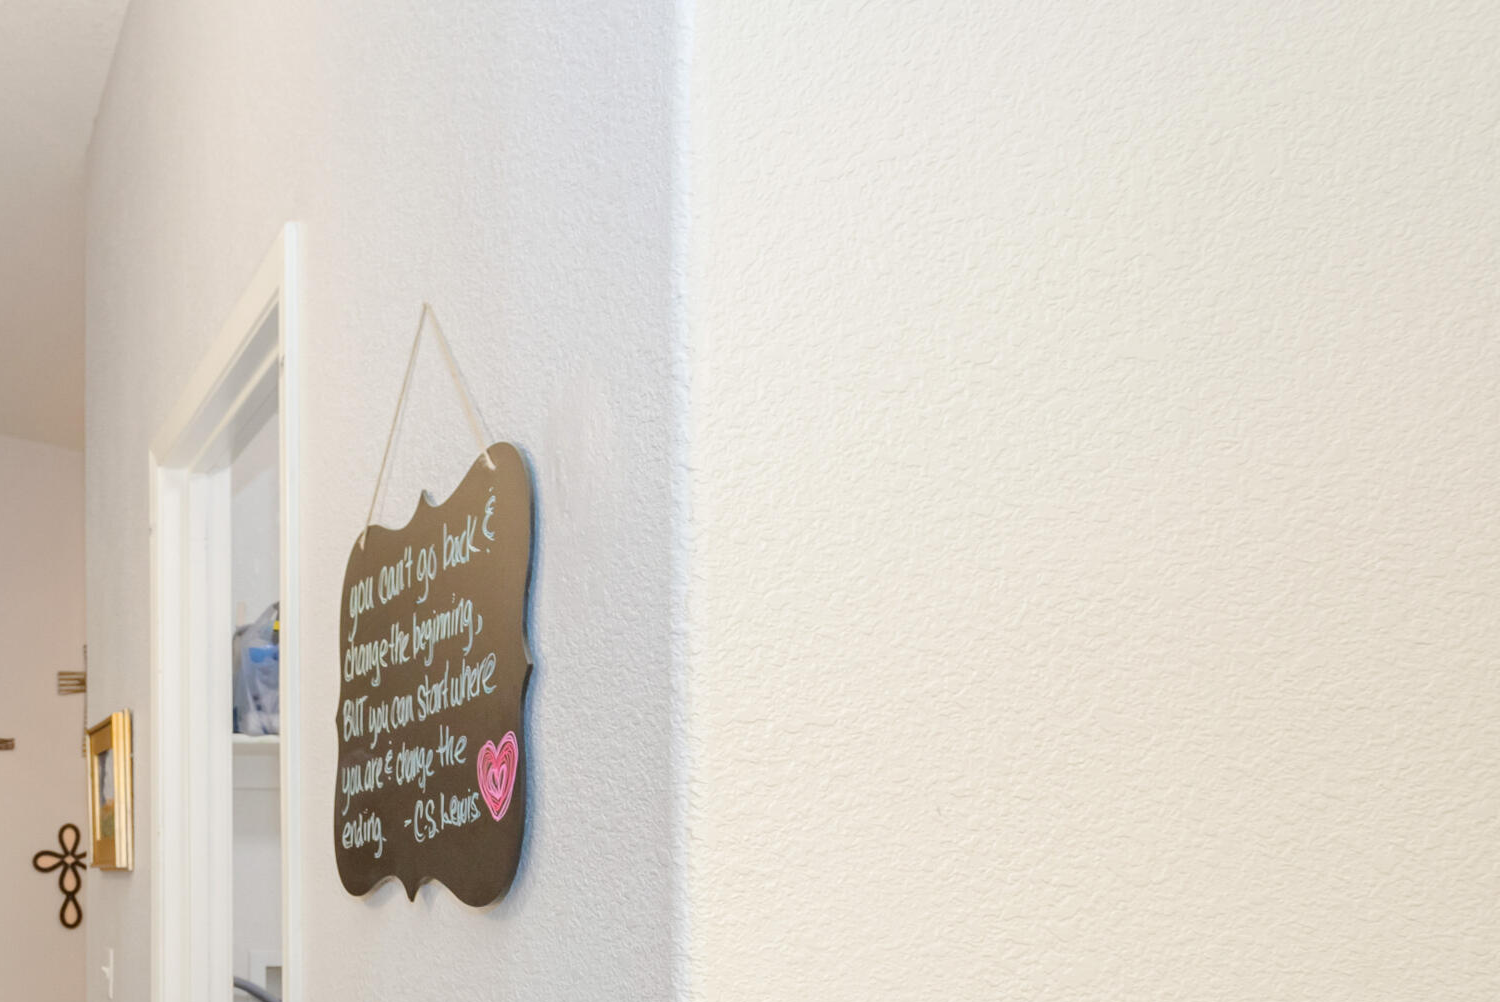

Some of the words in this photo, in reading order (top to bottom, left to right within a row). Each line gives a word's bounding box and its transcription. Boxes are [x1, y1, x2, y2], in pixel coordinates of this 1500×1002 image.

[378, 545, 414, 604] can't
[416, 544, 437, 604] go
[442, 515, 481, 571] back
[344, 637, 388, 687] change
[388, 622, 411, 665] the
[343, 695, 368, 742] BUT
[368, 701, 390, 749] you
[391, 695, 414, 729] can
[417, 660, 449, 721] start
[450, 652, 497, 707] where
[342, 764, 364, 816] you
[364, 756, 384, 792] are
[396, 742, 435, 793] change
[436, 724, 468, 768] the
[440, 788, 482, 830] Lewis
